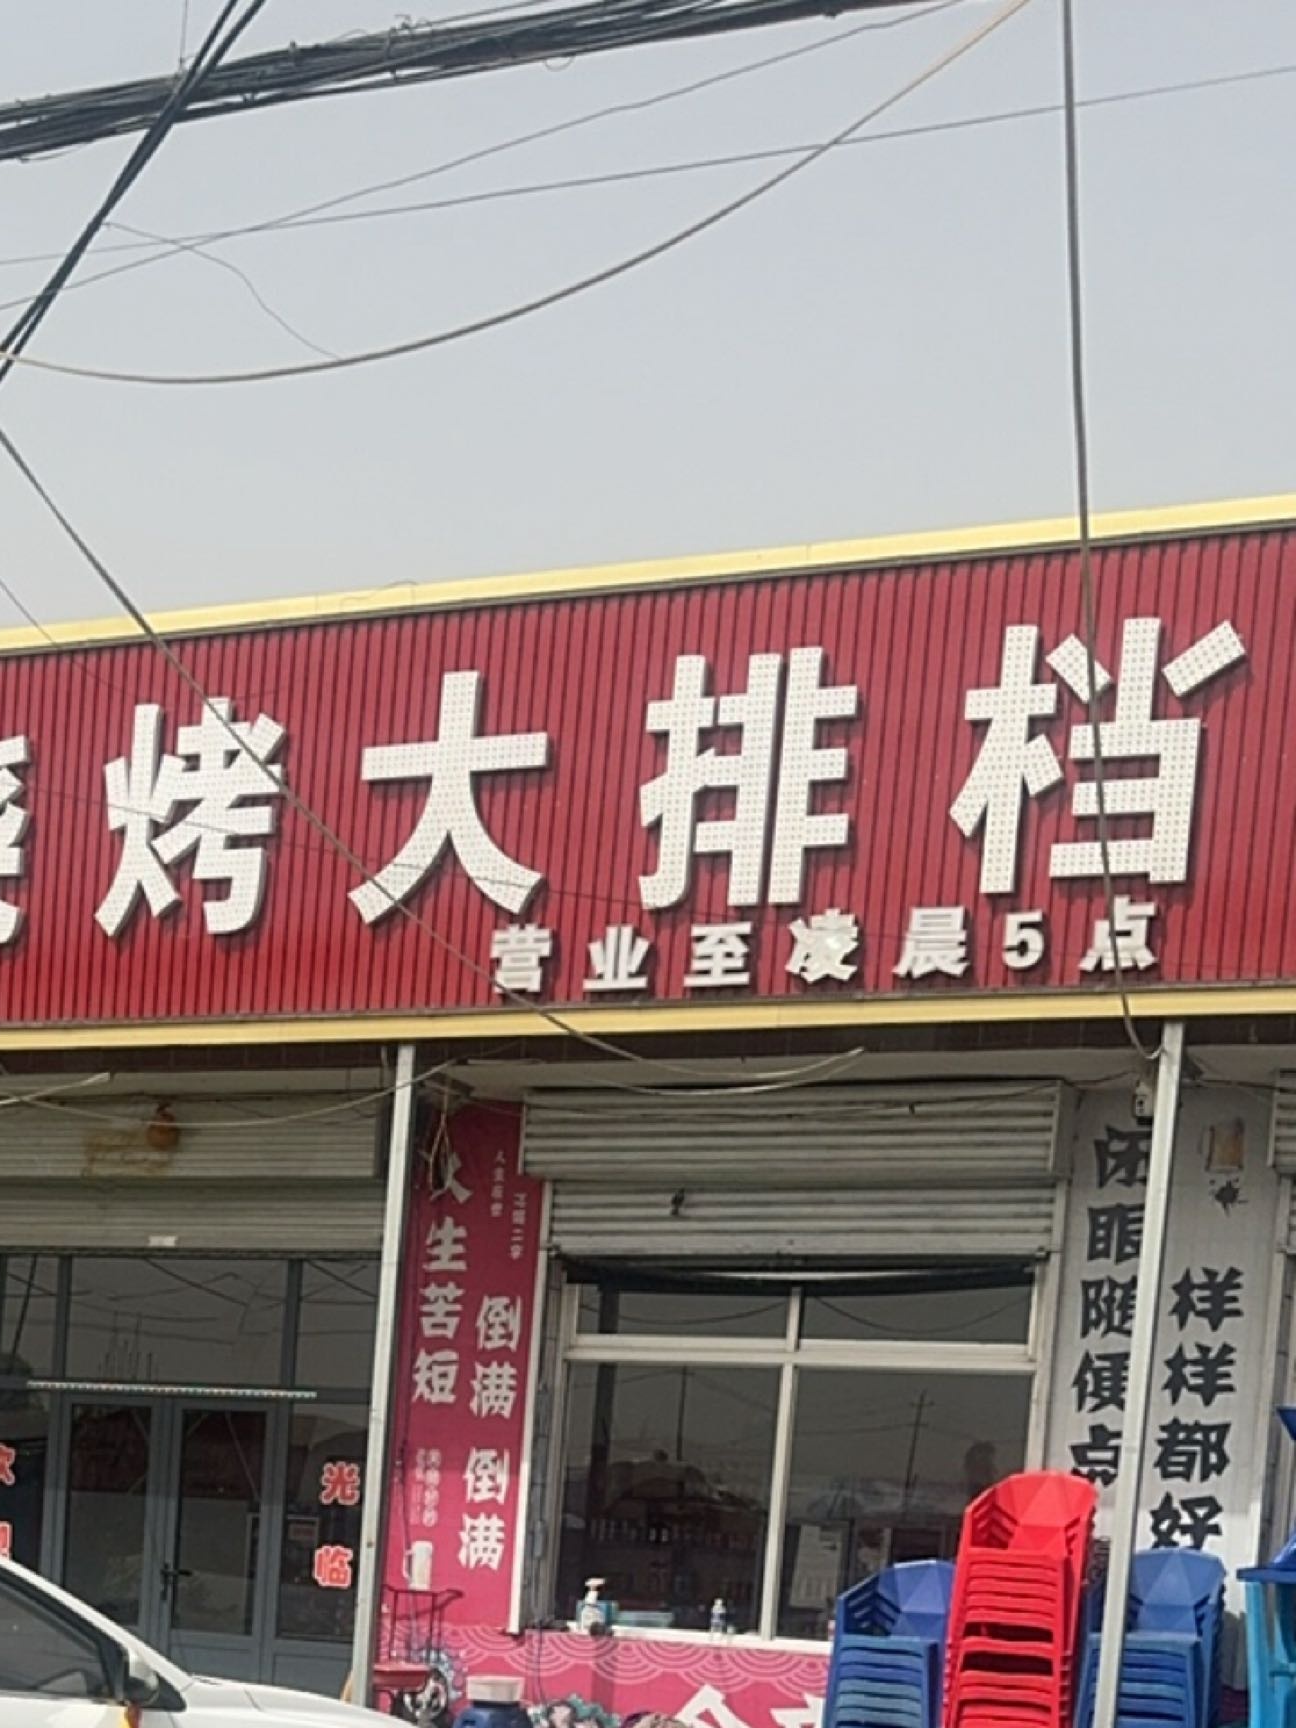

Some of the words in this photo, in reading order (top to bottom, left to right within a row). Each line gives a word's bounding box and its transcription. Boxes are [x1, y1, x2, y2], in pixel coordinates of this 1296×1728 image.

[489, 896, 1158, 995] 营业至凌晨5点
[313, 1461, 360, 1588] 光临
